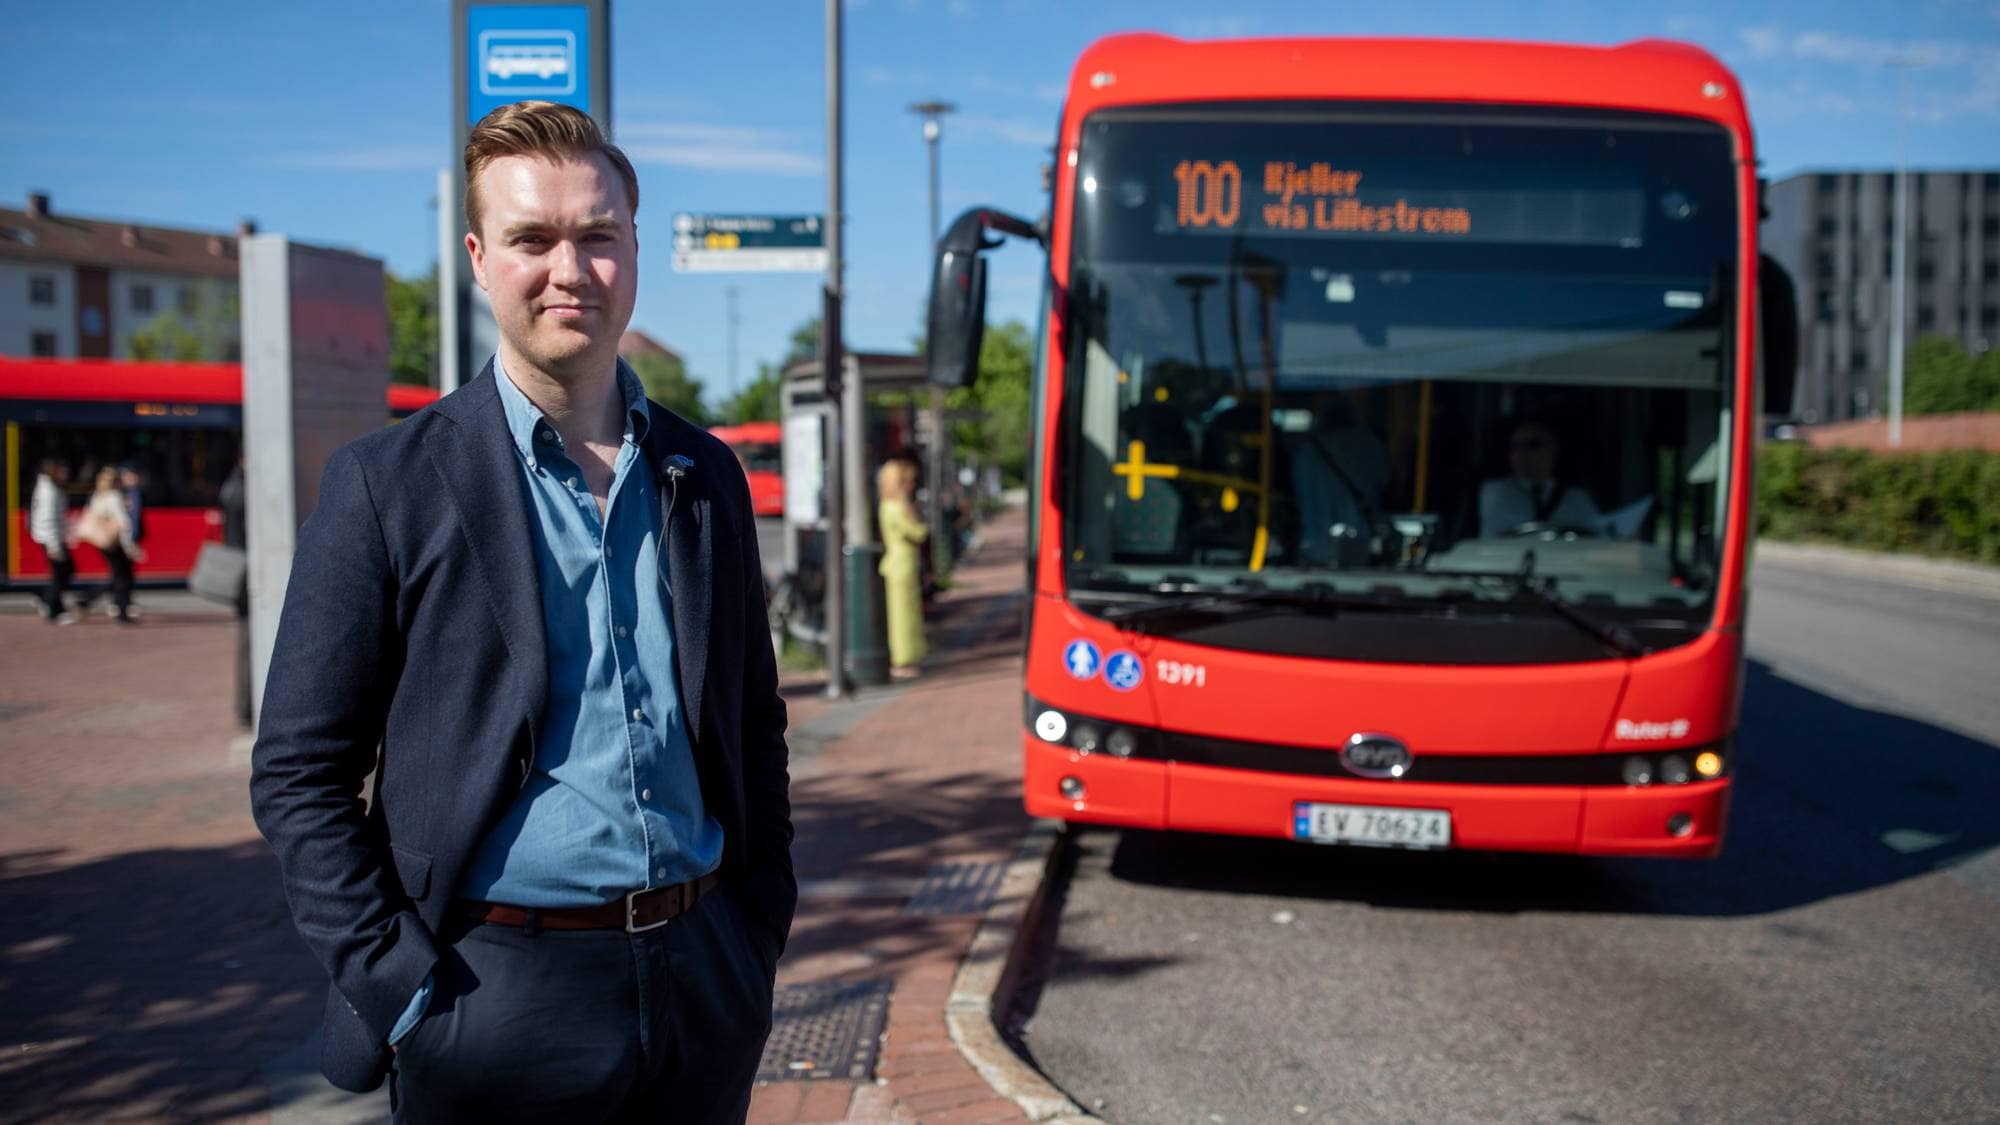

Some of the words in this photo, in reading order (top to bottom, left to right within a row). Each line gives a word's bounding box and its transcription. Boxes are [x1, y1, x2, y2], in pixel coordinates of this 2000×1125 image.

[1174, 160, 1241, 228] 100
[1264, 162, 1362, 204] Kjeller
[1263, 203, 1308, 229] via
[1157, 659, 1206, 687] 1391
[1317, 810, 1350, 835] EV
[1361, 813, 1441, 841] 70624
